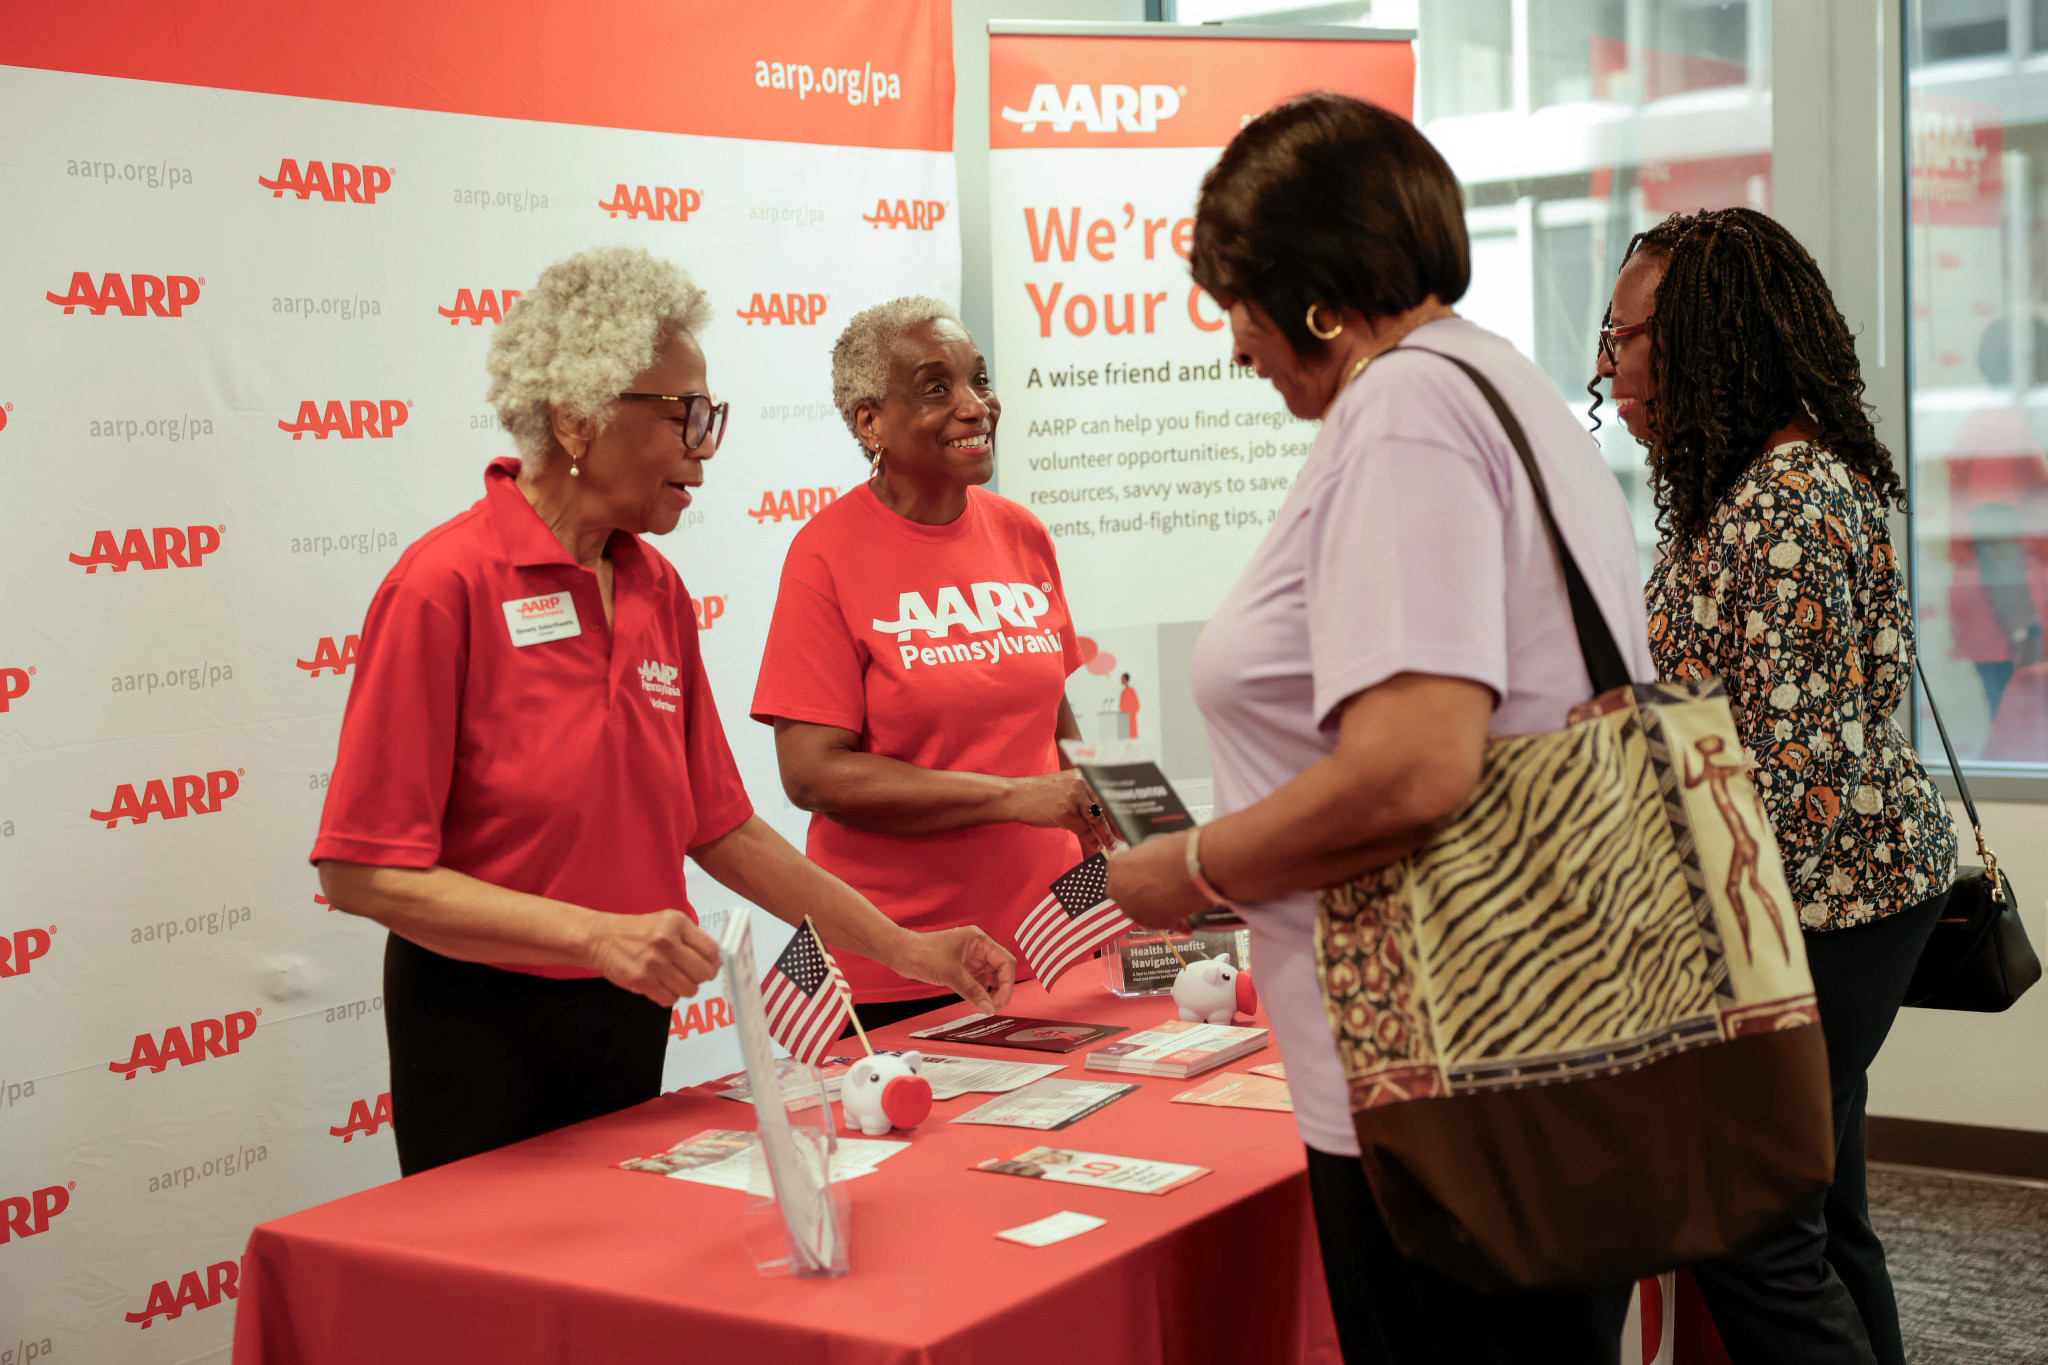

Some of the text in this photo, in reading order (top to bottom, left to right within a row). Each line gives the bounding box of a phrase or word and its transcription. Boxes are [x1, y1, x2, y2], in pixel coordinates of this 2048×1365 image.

[754, 60, 901, 107] aarp.org/pa
[66, 158, 193, 189] aarp.org/pa
[453, 186, 549, 213] aarp.org/pa
[749, 204, 825, 226] aarp.org/pa
[272, 294, 381, 321] aarp.org/pa
[438, 288, 523, 326] AA
[1026, 282, 1167, 339] Your
[1026, 367, 1043, 389] A
[1049, 365, 1099, 388] wise
[1105, 360, 1171, 386] friend
[1178, 359, 1221, 382] and
[89, 413, 214, 443] aarp.org/pa
[1028, 418, 1077, 438] AARP
[1081, 419, 1110, 435] can
[1114, 414, 1151, 435] help
[1156, 415, 1189, 435] you
[1194, 409, 1230, 428] find
[1029, 451, 1113, 472] volunteer
[1117, 443, 1245, 469] opportunities,
[1248, 440, 1277, 464] job
[1030, 484, 1120, 505] resources,
[1124, 481, 1172, 501] savvy
[1176, 478, 1222, 500] ways
[1227, 476, 1245, 493] to
[1048, 521, 1096, 538] vents,
[1099, 510, 1220, 535] fraud-fighting
[1225, 507, 1263, 528] tips,
[290, 527, 398, 555] aarp.org/pa
[296, 634, 361, 678] AA
[111, 661, 233, 695] aarp.org/pa
[130, 904, 252, 945] aarp.org/pa
[1130, 945, 1163, 957] Health
[325, 996, 383, 1023] aarp.o
[329, 1091, 394, 1144] AA
[148, 1144, 268, 1194] aarp.org/pa
[125, 1260, 240, 1330] AAR
